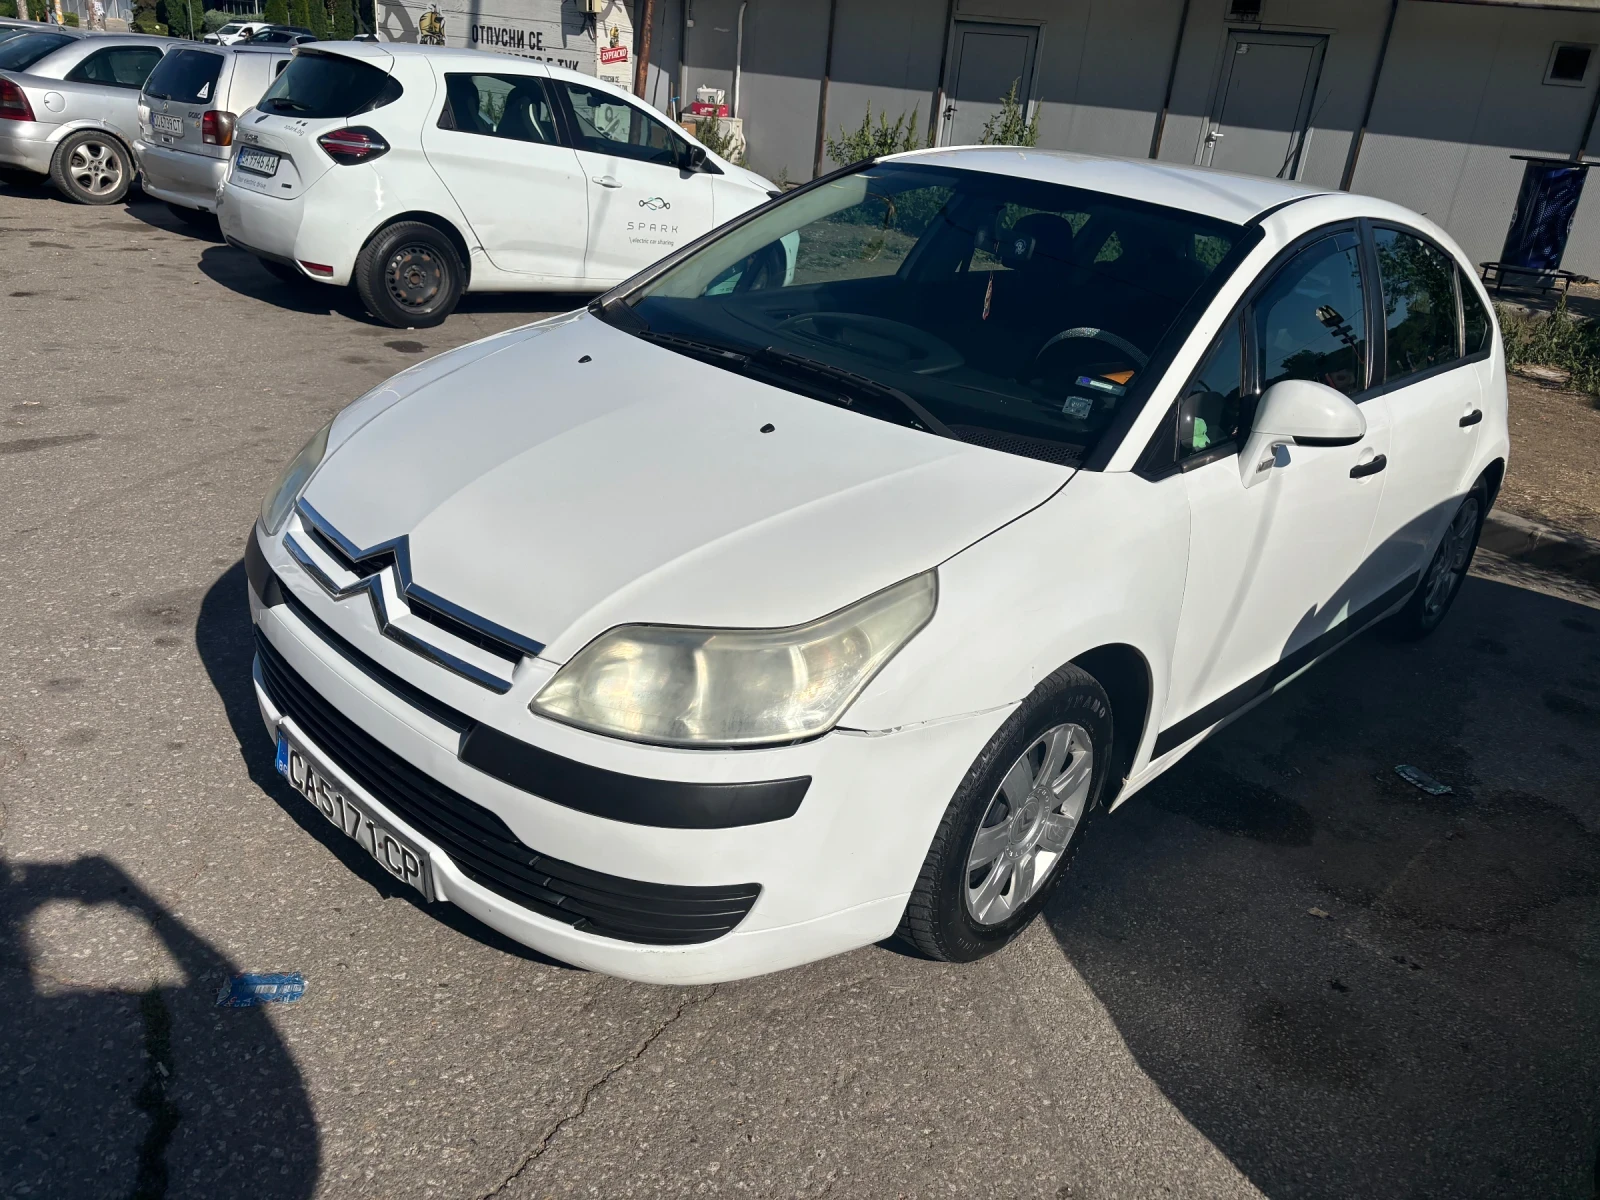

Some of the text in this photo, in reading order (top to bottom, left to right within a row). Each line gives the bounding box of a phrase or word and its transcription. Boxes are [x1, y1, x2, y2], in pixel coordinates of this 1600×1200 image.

[472, 24, 525, 49] ОТПУСНИ
[626, 221, 679, 234] SPARK
[278, 761, 288, 775] BG
[290, 749, 421, 887] CA5171CP
